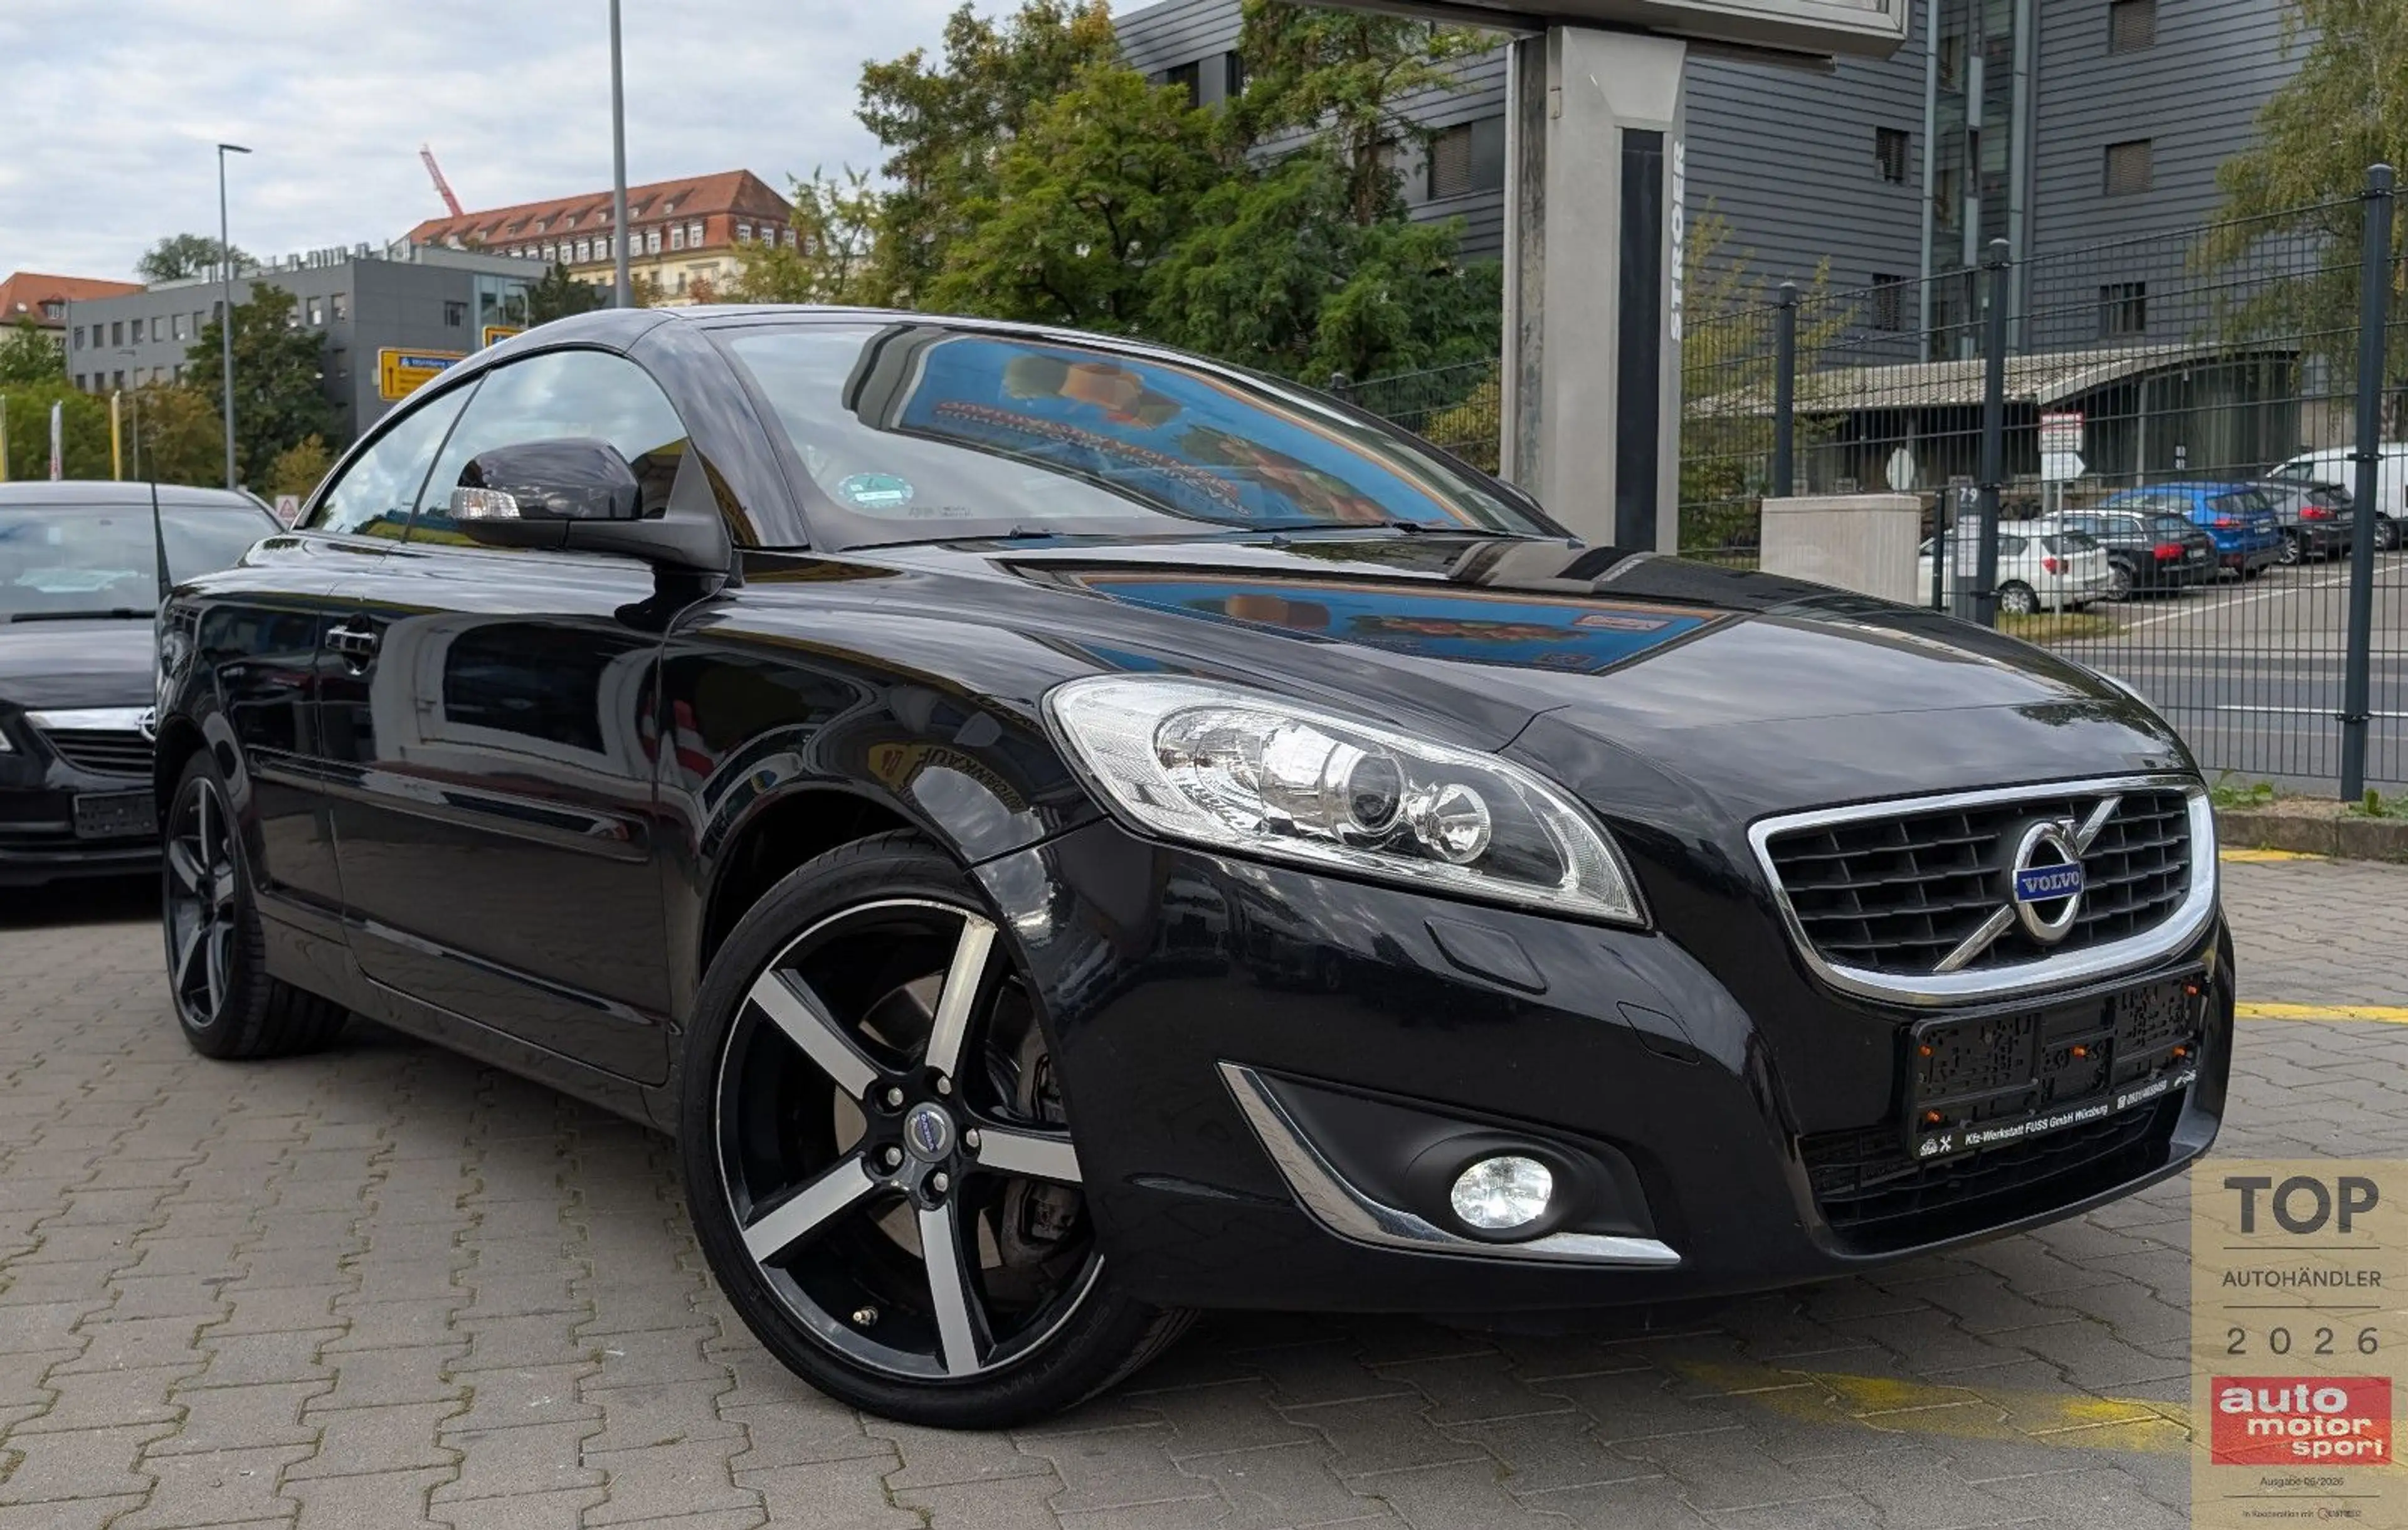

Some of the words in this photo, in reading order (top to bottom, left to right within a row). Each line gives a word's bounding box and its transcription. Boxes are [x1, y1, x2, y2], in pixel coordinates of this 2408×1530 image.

[2022, 871, 2079, 893] VOLVO
[1965, 1123, 2024, 1146] Kfz-Werkstatt
[2025, 1117, 2049, 1134] FUSS
[2050, 1112, 2074, 1129] GmbH
[2075, 1104, 2109, 1122] Würzburg
